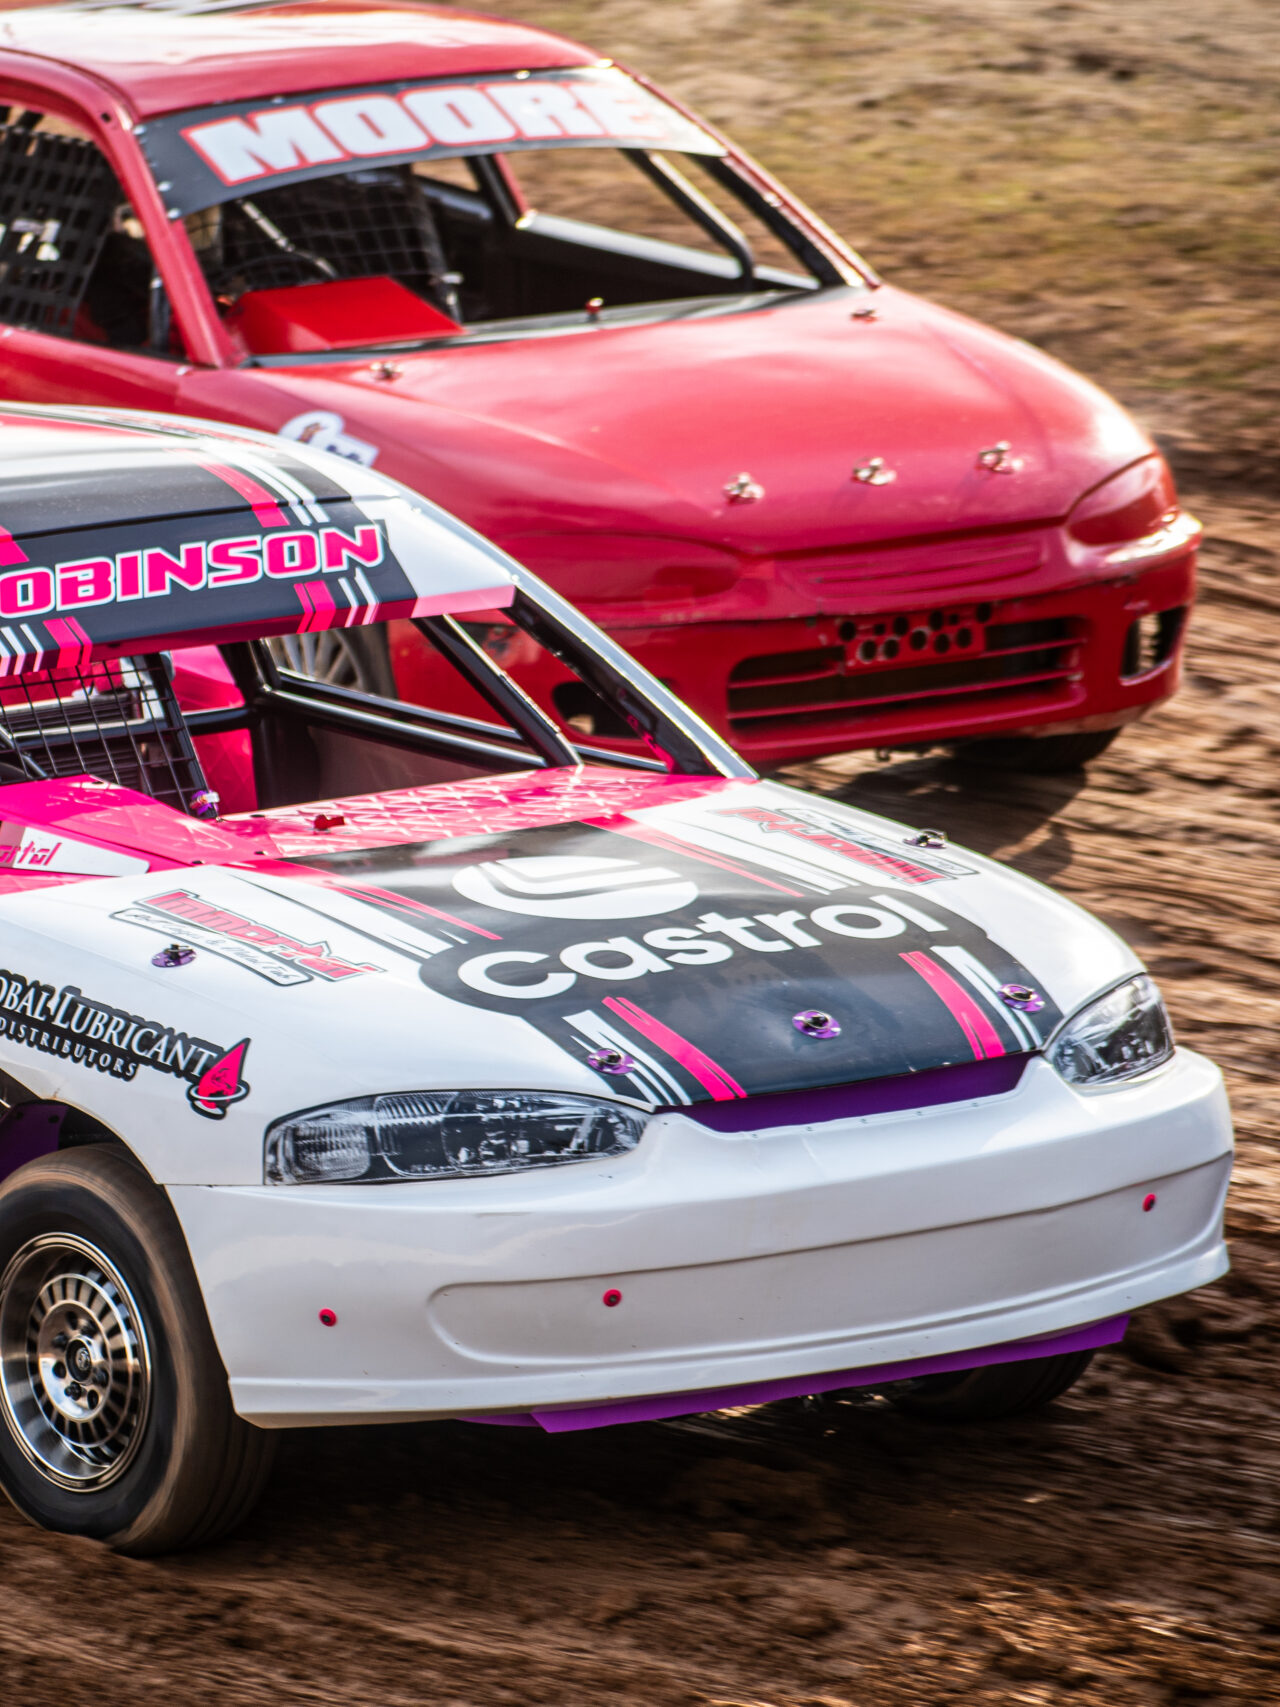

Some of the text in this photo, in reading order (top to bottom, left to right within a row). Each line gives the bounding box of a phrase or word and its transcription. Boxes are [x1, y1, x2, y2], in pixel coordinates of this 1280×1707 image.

[180, 81, 669, 187] MOORE
[142, 890, 380, 980] Immortal
[458, 894, 949, 999] Castrol
[52, 991, 219, 1078] LUBRICANT
